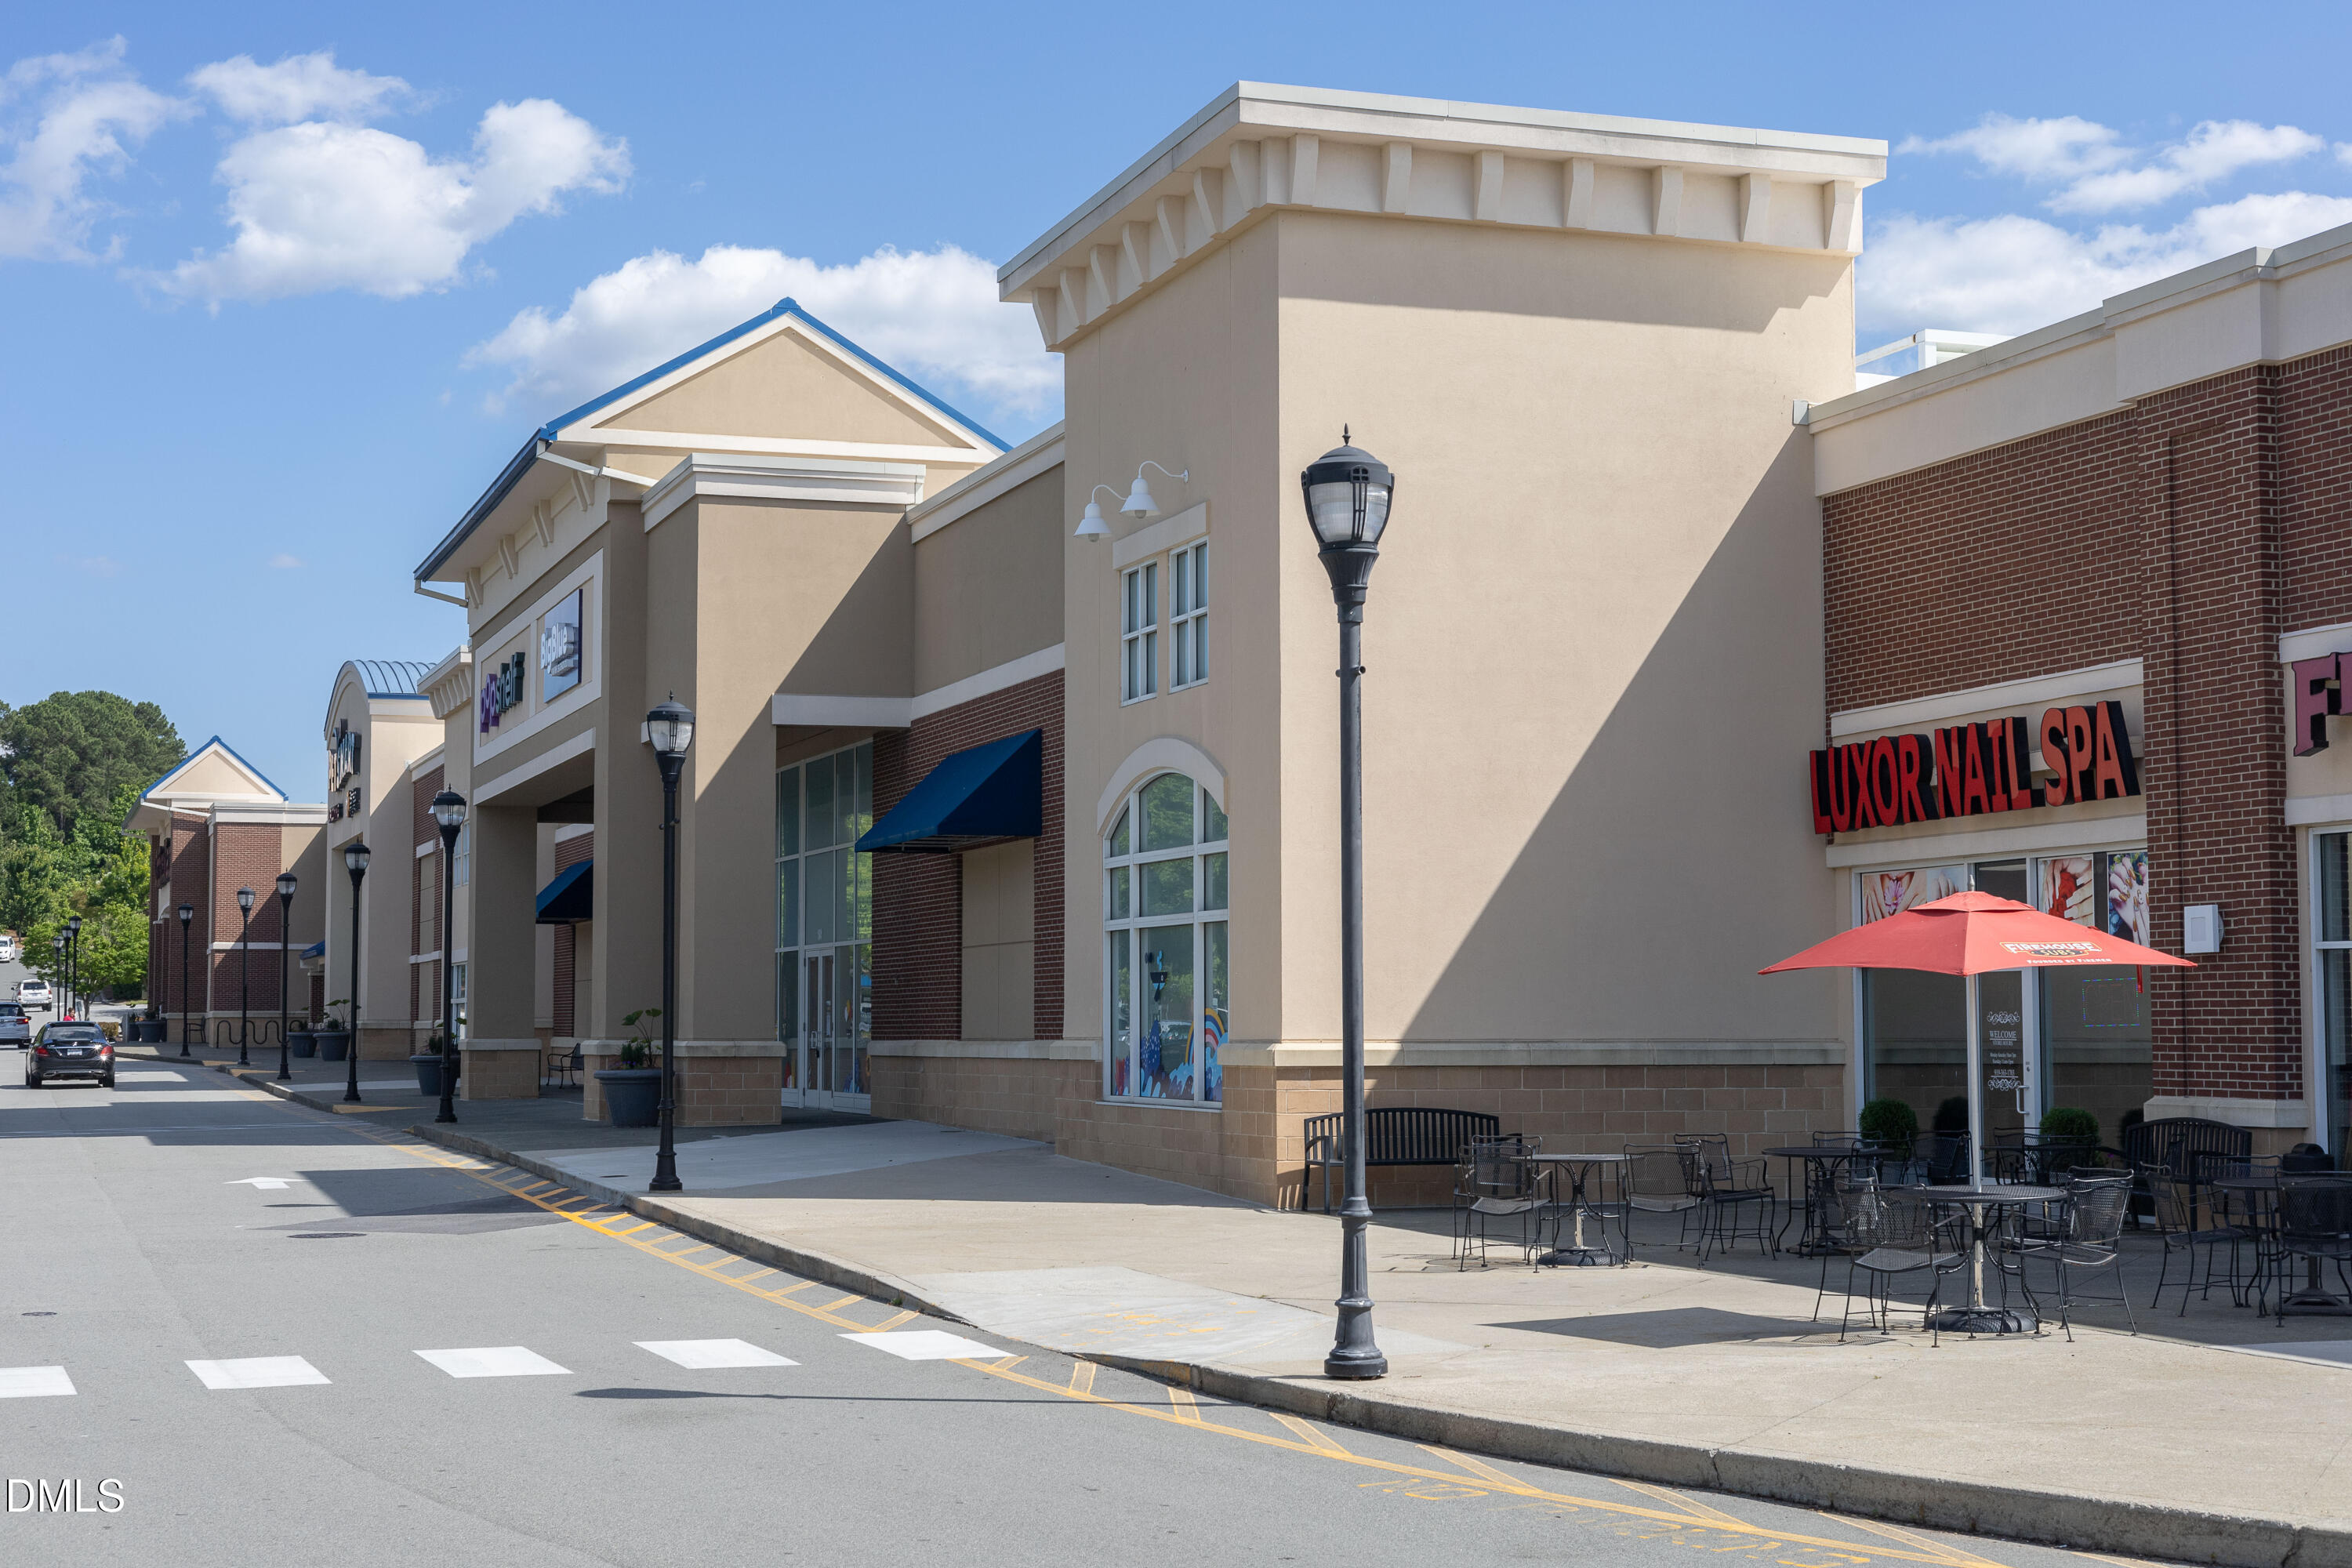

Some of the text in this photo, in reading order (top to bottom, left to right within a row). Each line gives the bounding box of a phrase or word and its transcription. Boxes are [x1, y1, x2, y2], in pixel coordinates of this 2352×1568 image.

[480, 652, 523, 732] popshelf
[1809, 701, 2134, 834] LUXOR NAIL SPA
[2004, 942, 2101, 953] FIREHOUSE
[1989, 1030, 2016, 1039] WELCOME
